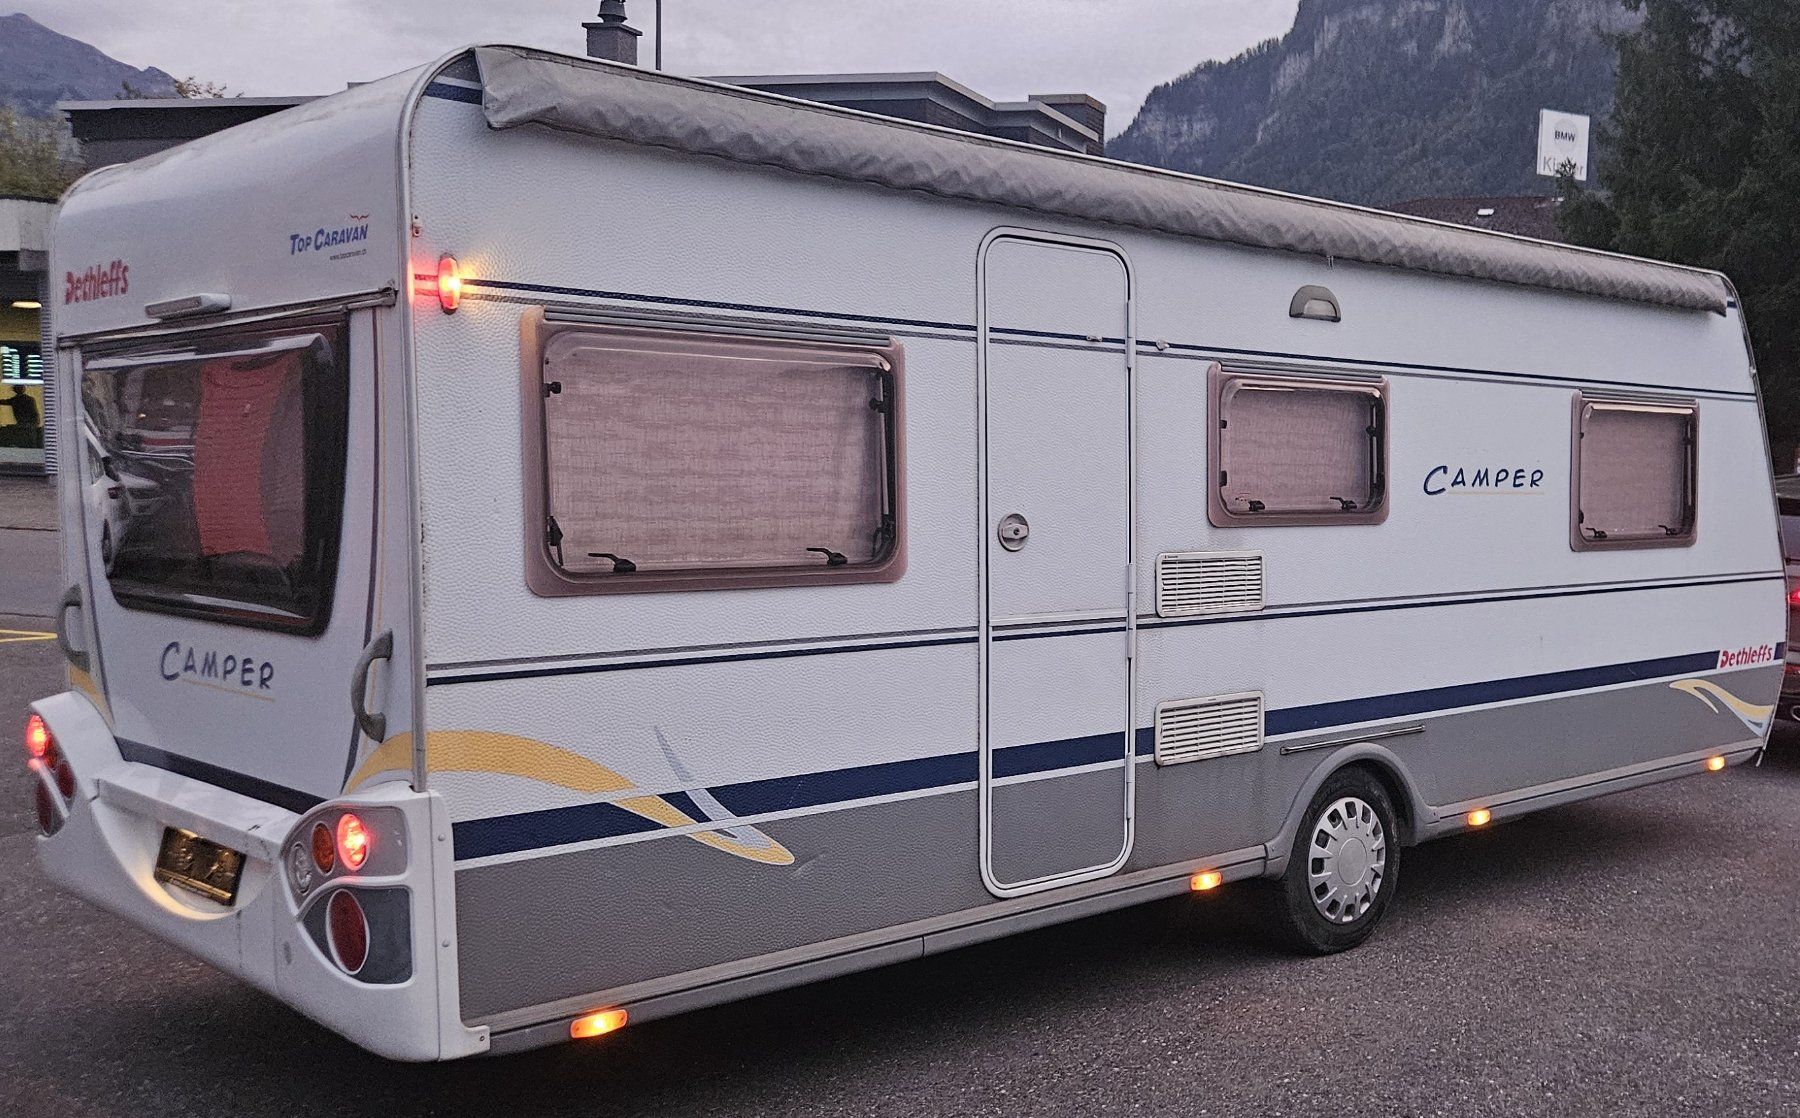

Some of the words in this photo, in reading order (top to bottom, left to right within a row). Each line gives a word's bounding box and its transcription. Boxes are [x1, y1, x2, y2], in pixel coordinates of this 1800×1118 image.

[1554, 130, 1576, 142] BMW
[290, 233, 312, 255] TOP
[314, 223, 369, 251] CARAVAN
[65, 259, 129, 305] Dethleffs
[1423, 465, 1544, 495] CAMPER
[160, 641, 275, 689] CAMPER
[1720, 644, 1773, 668] Dethleffs
